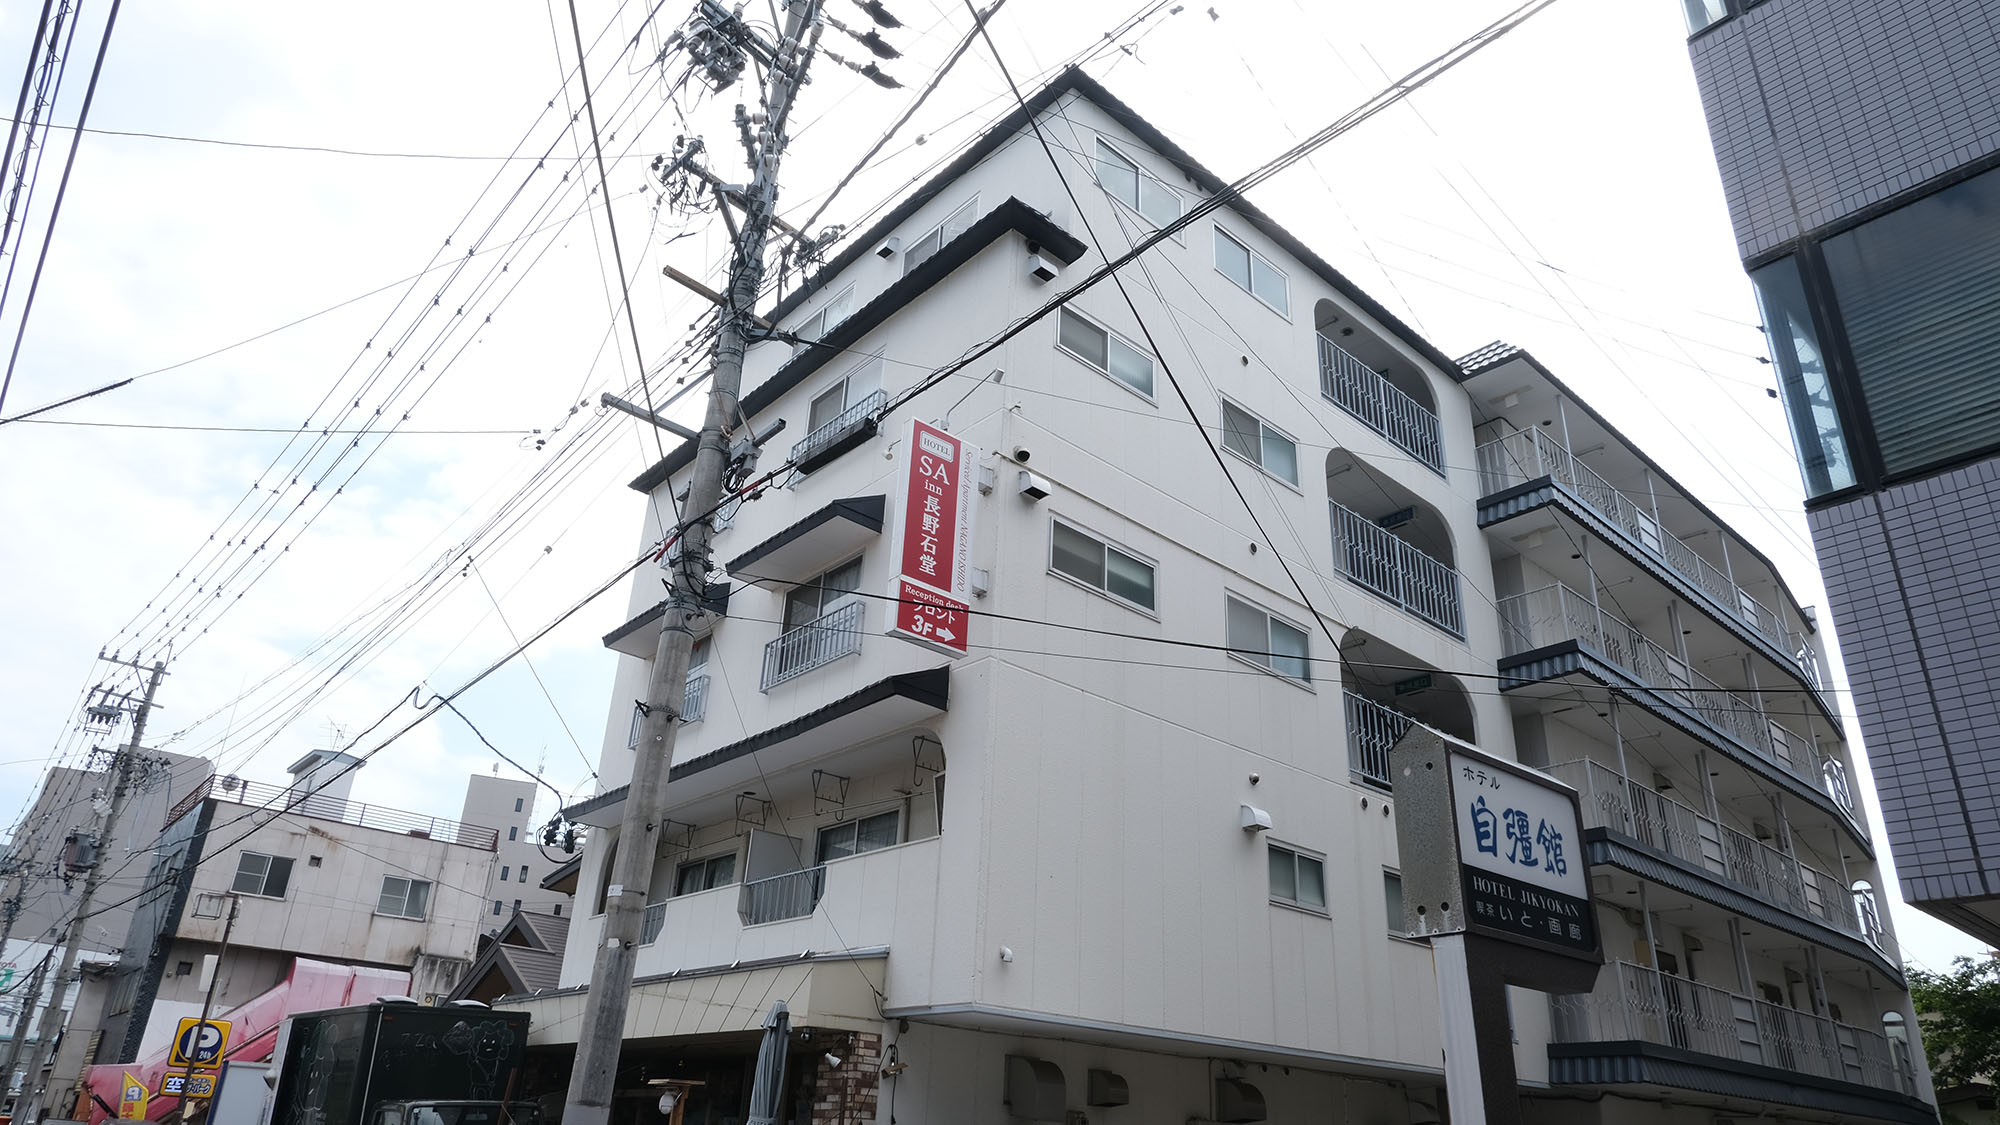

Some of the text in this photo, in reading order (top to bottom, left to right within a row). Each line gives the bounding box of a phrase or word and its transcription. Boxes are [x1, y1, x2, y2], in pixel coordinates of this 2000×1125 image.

[923, 437, 951, 456] HOTEL
[919, 455, 950, 485] SA
[925, 479, 943, 496] inn
[957, 449, 974, 593] Serviced Apartment NAGANO ISHIDO
[919, 495, 942, 577] 長野石堂
[905, 584, 944, 607] Reception
[912, 598, 956, 624] フロント
[911, 614, 934, 636] 3F
[1463, 765, 1501, 790] ホテル
[1473, 876, 1580, 918] HOTEL JIKYOKAN
[185, 1026, 220, 1058] P
[164, 1077, 185, 1093] 空
